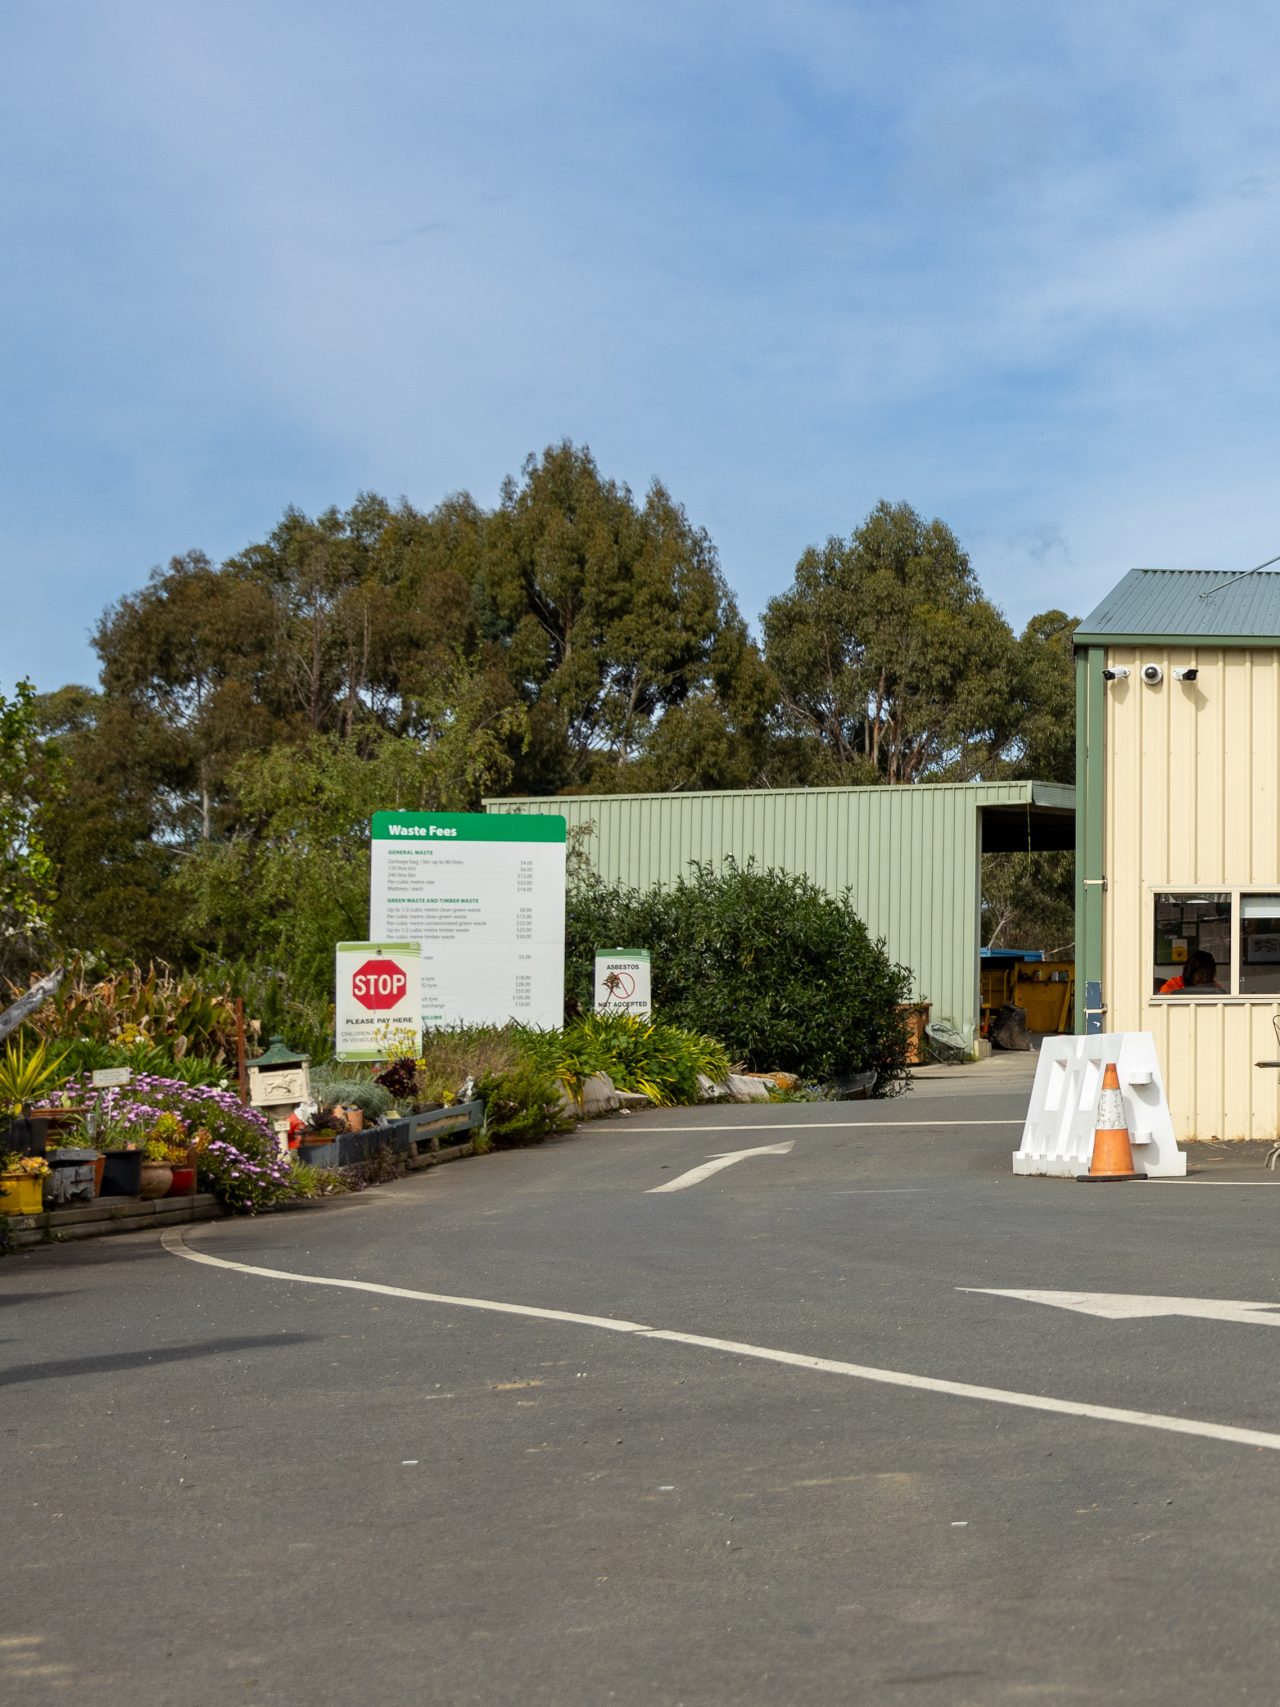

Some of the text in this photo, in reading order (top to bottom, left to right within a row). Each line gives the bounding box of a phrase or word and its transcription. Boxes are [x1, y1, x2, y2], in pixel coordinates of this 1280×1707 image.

[389, 825, 457, 836] Waste Fees
[354, 974, 406, 996] STOP
